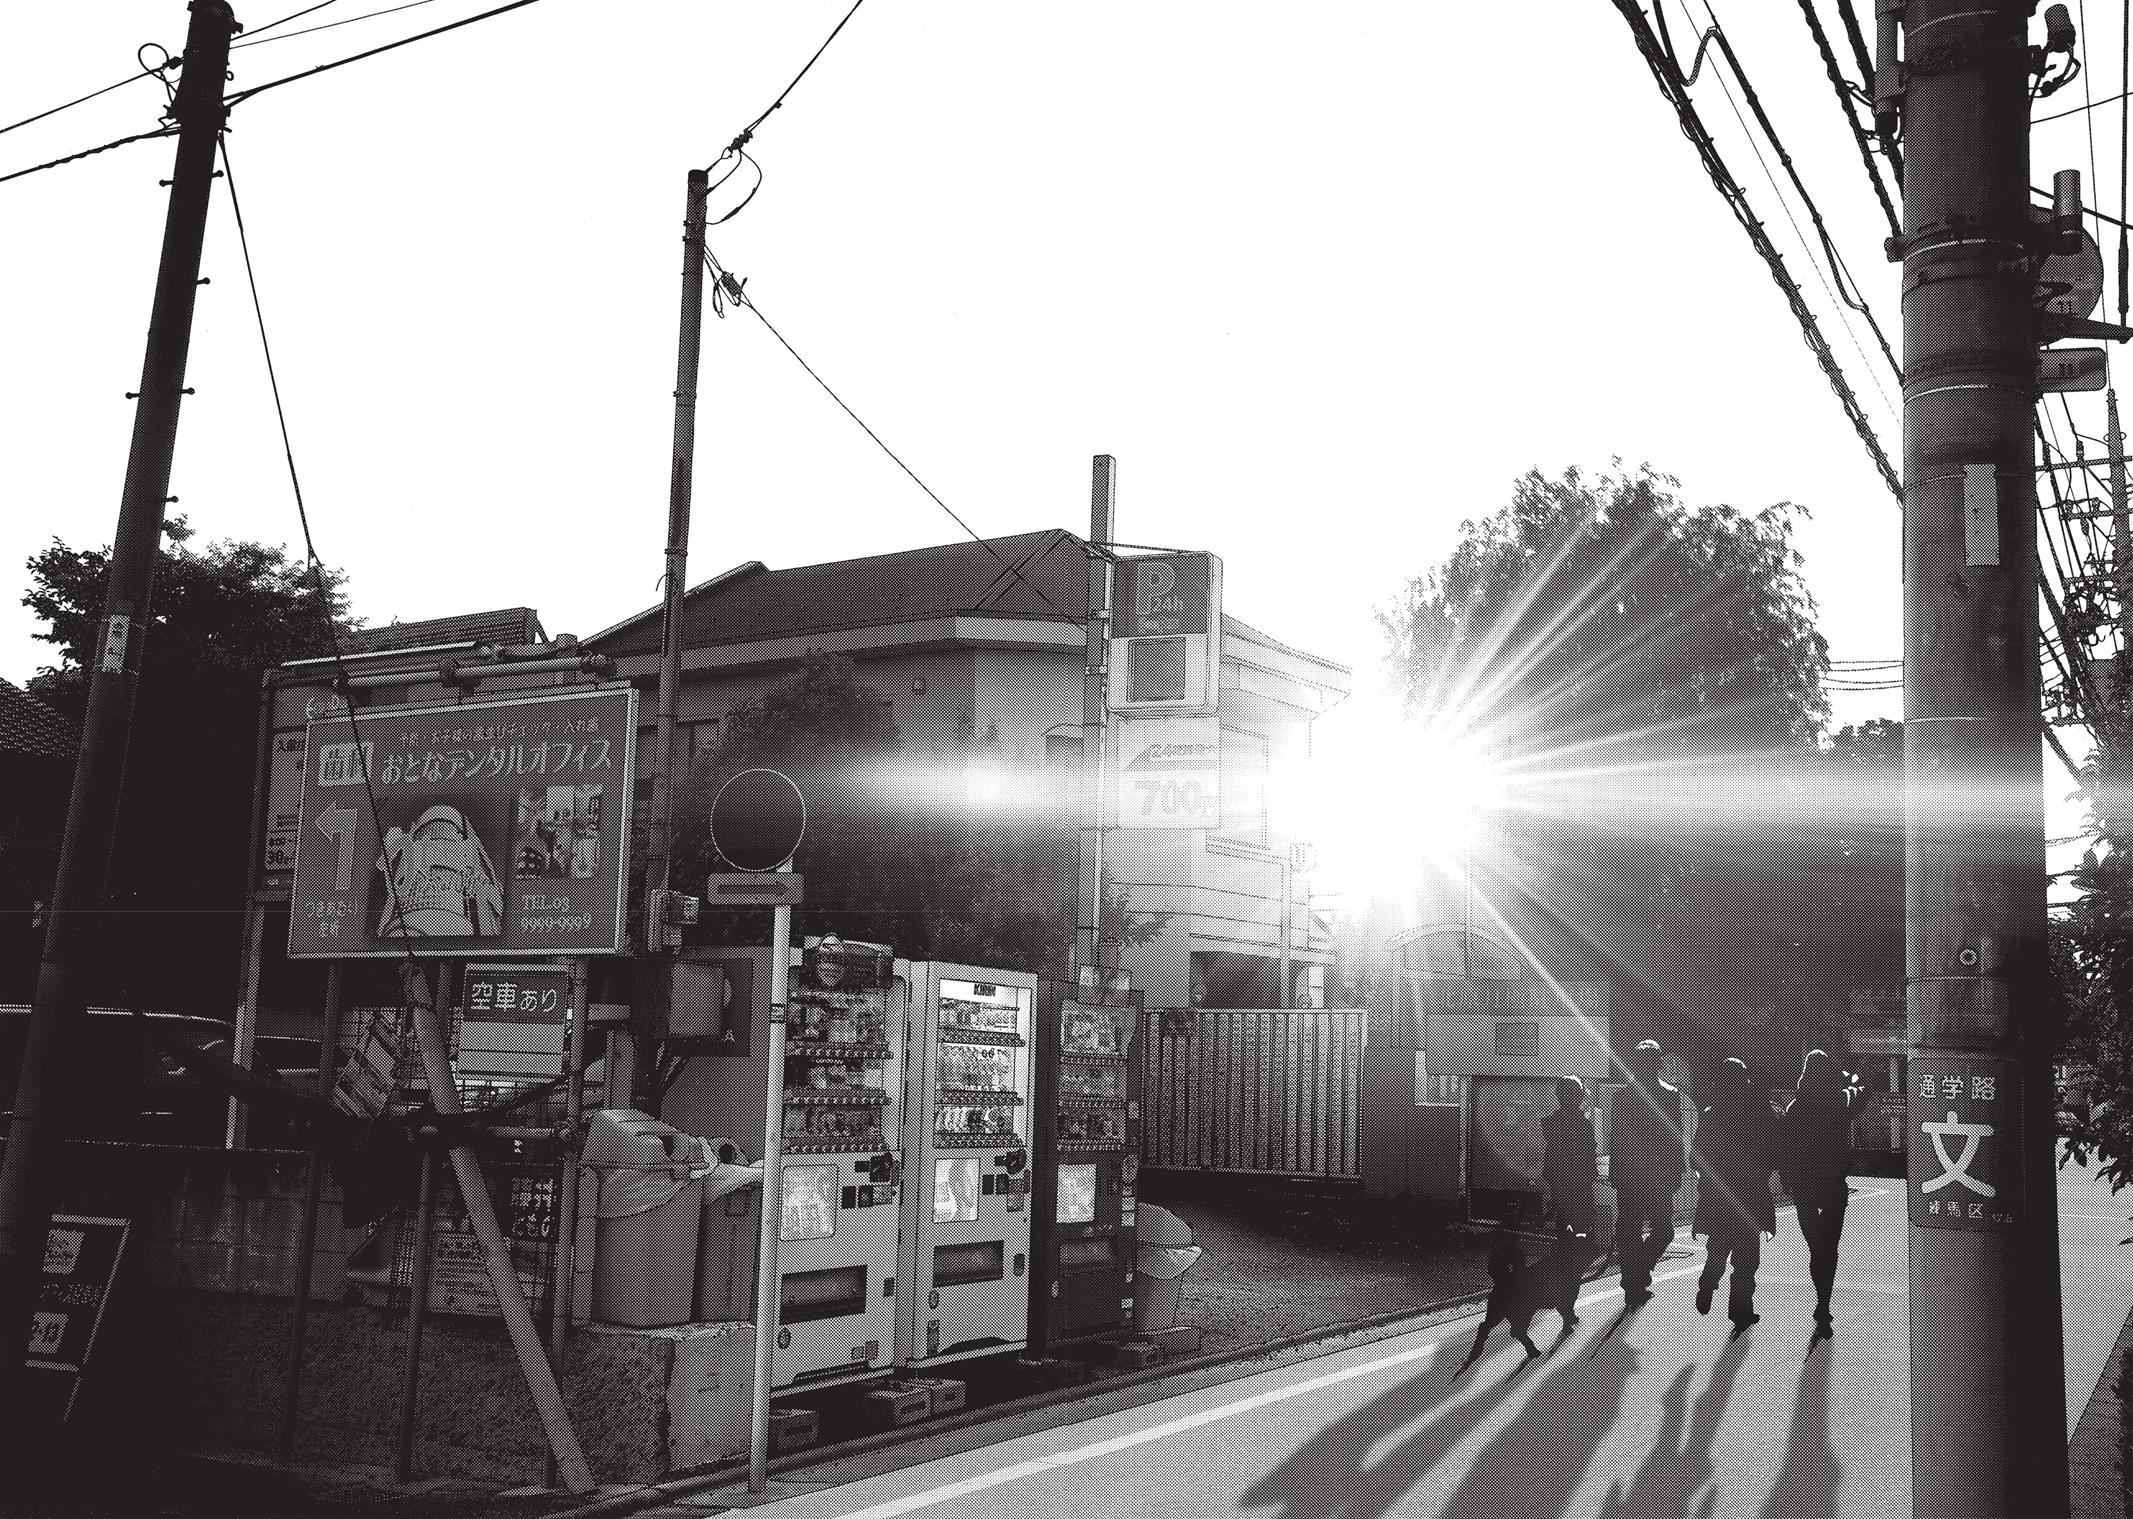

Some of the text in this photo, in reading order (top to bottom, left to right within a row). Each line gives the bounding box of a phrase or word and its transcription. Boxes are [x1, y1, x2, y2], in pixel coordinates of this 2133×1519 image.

[1150, 596, 1184, 613] 24h
[381, 738, 612, 784] おとなデンタルオフィス
[520, 912, 592, 934] 9999-9999
[470, 981, 558, 1013] 空車あり
[1919, 1074, 1996, 1101] 通学路
[1921, 1110, 1996, 1198] 文
